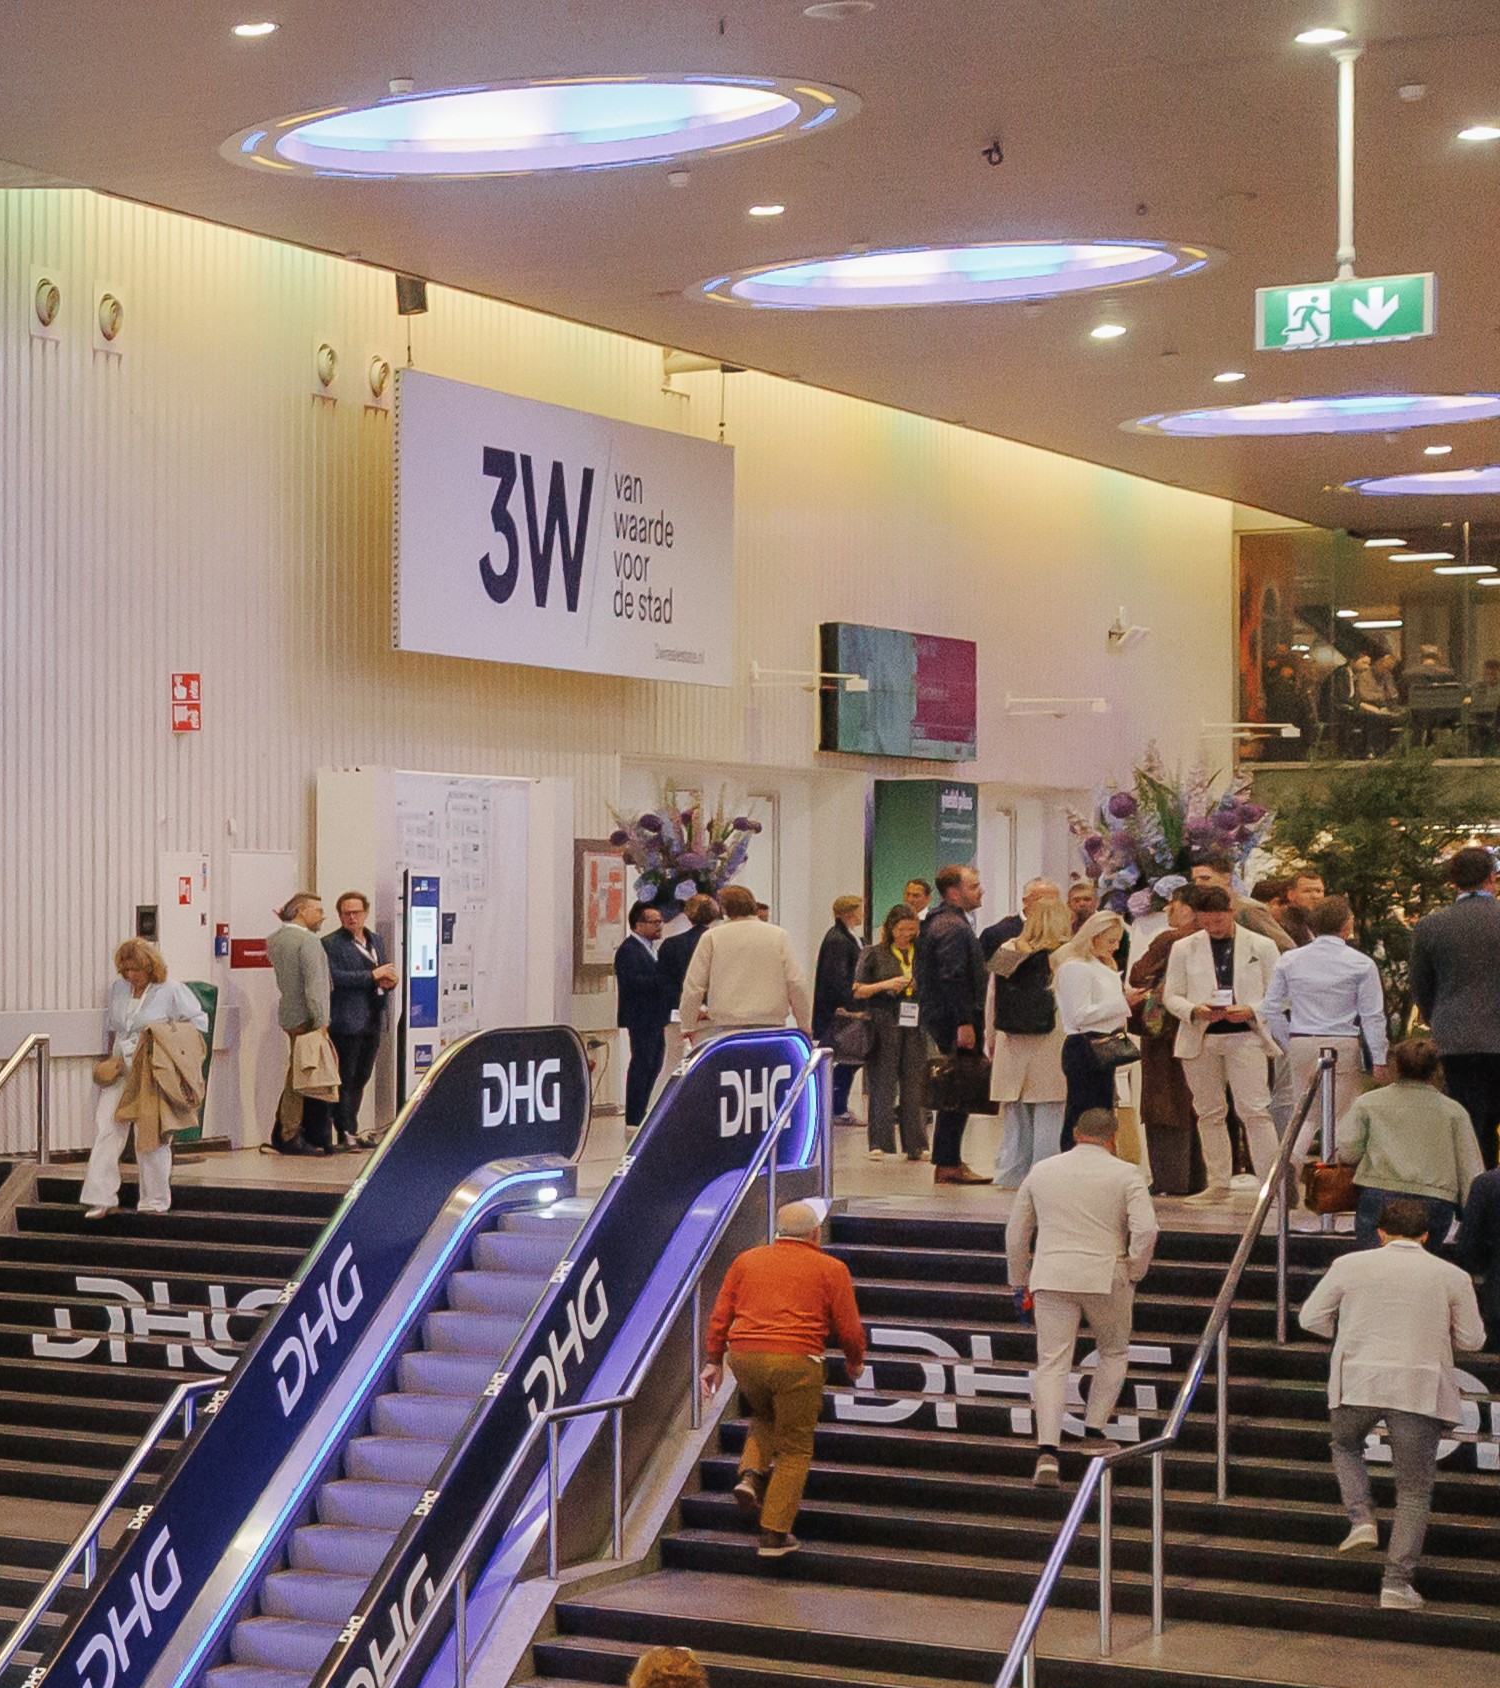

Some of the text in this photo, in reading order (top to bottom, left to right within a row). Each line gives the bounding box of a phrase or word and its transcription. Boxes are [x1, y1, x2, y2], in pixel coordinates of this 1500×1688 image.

[614, 471, 643, 504] van
[479, 446, 594, 613] 3W
[614, 510, 674, 549] waarde
[614, 550, 650, 582] voor
[613, 580, 673, 624] de stad
[482, 1058, 561, 1128] DHG
[720, 1064, 792, 1138] DHG
[272, 1242, 364, 1418] DHG
[523, 1257, 609, 1426] DHG
